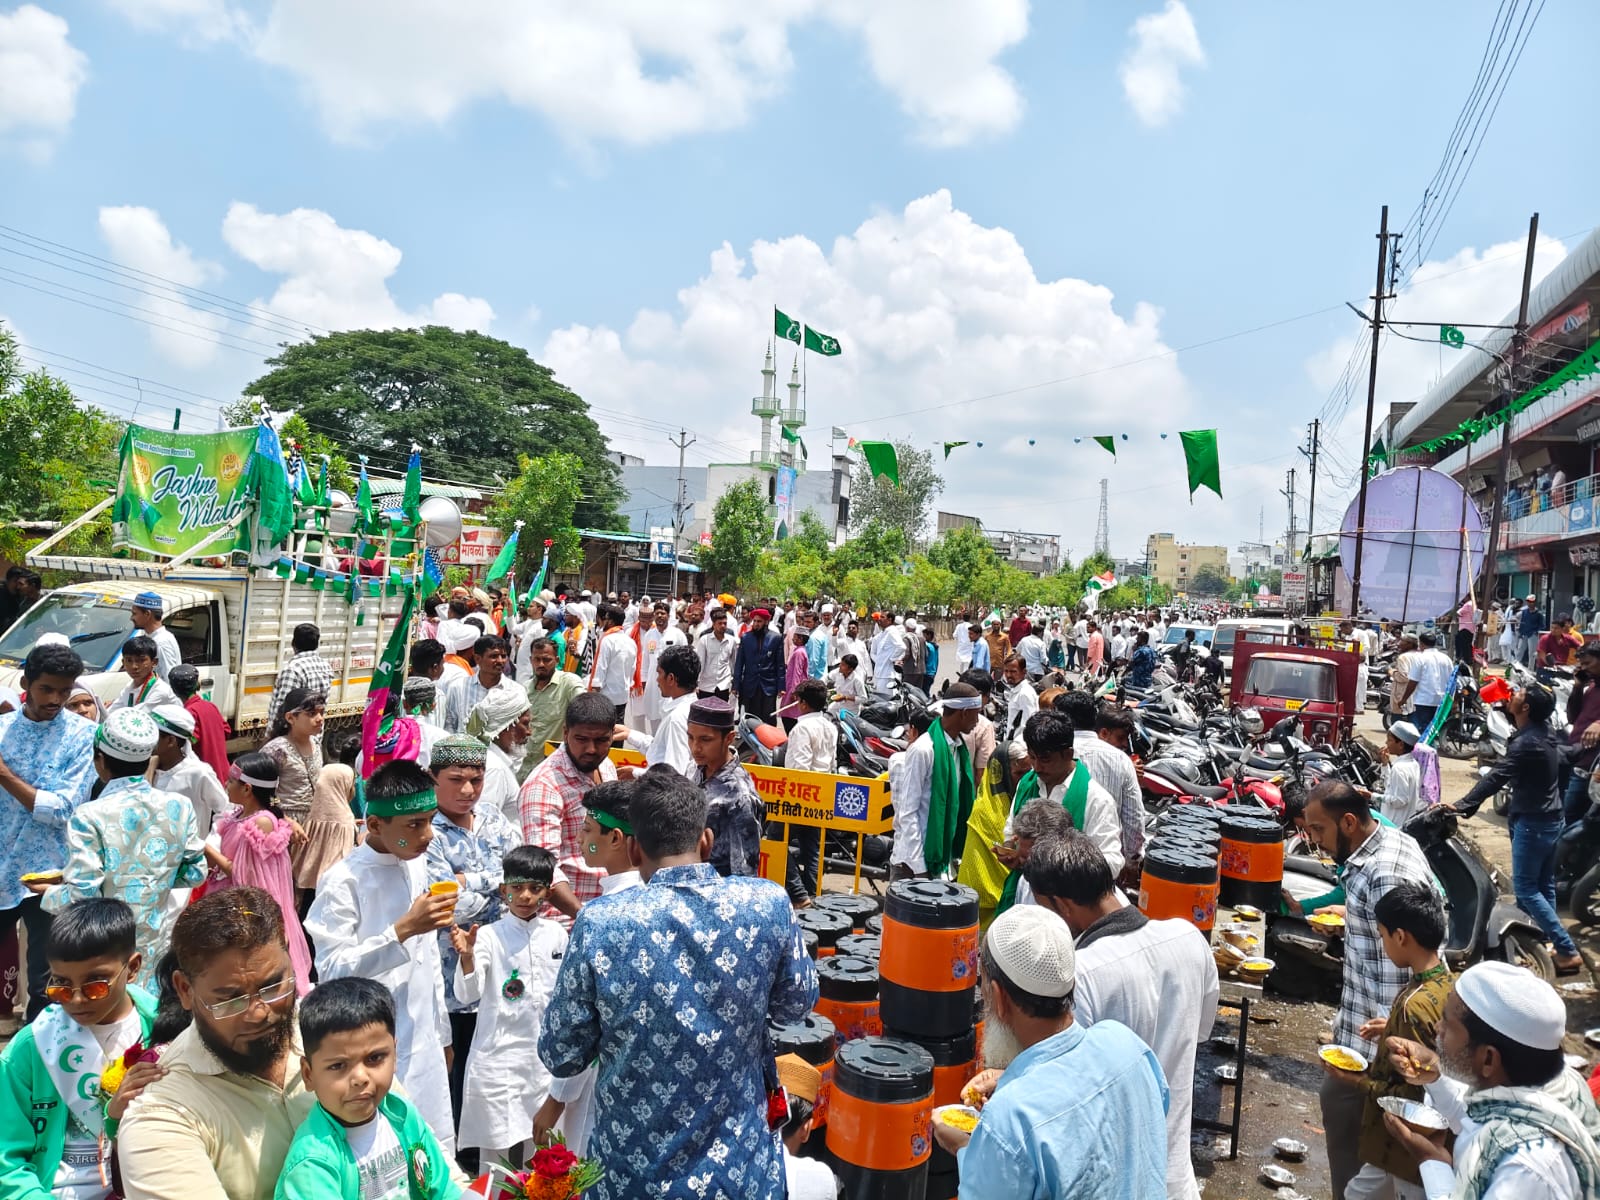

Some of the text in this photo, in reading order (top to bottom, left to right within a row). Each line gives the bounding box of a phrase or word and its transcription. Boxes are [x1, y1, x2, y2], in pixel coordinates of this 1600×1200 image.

[152, 463, 217, 502] Jashne
[788, 781, 821, 803] शहर
[781, 800, 802, 817] सिटी
